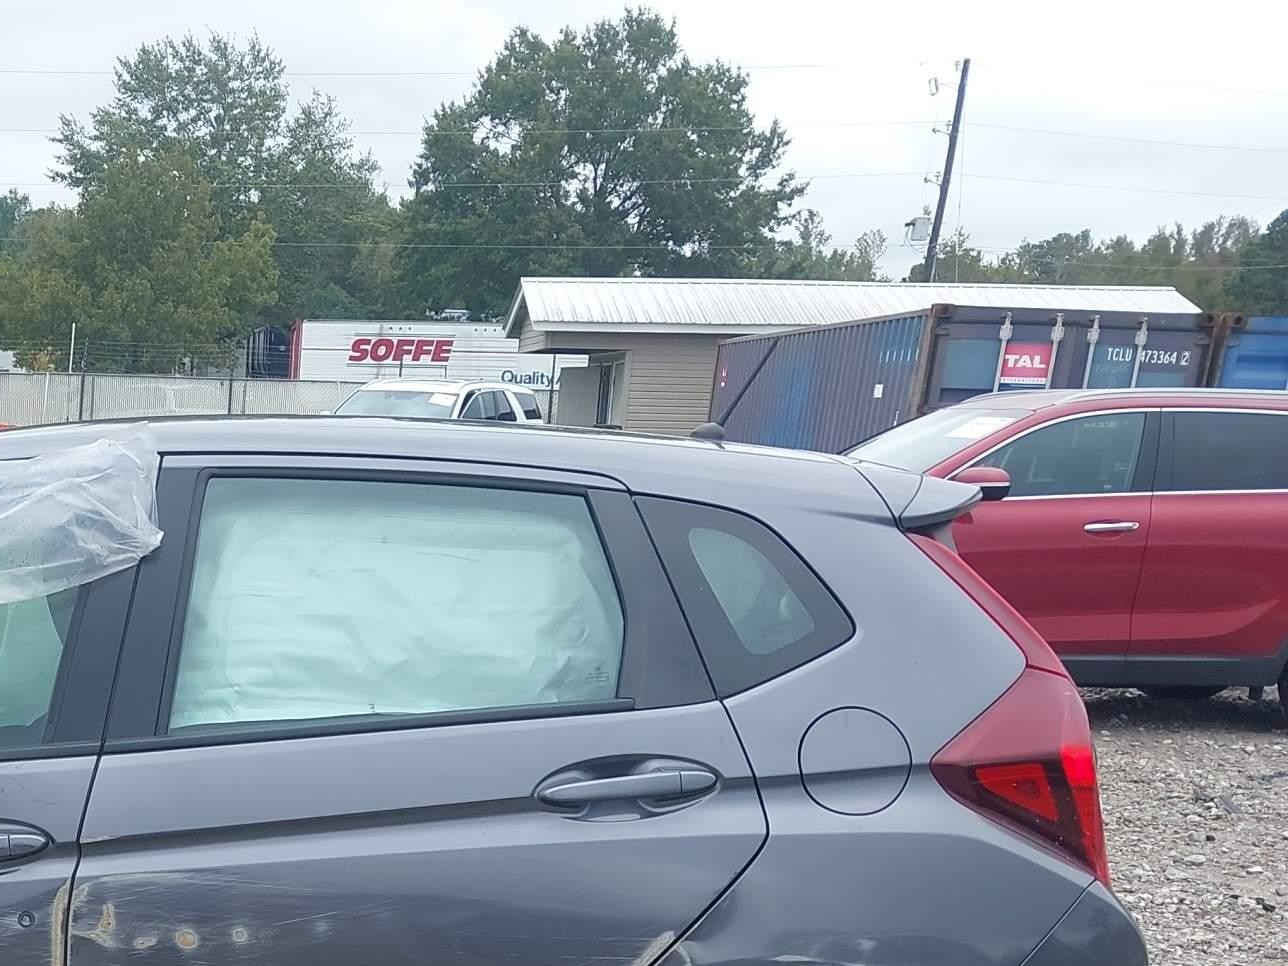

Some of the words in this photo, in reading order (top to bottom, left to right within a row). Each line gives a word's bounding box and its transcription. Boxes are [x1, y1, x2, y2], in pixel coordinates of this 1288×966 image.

[348, 338, 454, 362] SOFFE
[1107, 347, 1133, 362] TCLU
[1005, 354, 1047, 368] TAL
[501, 370, 554, 387] Quality
